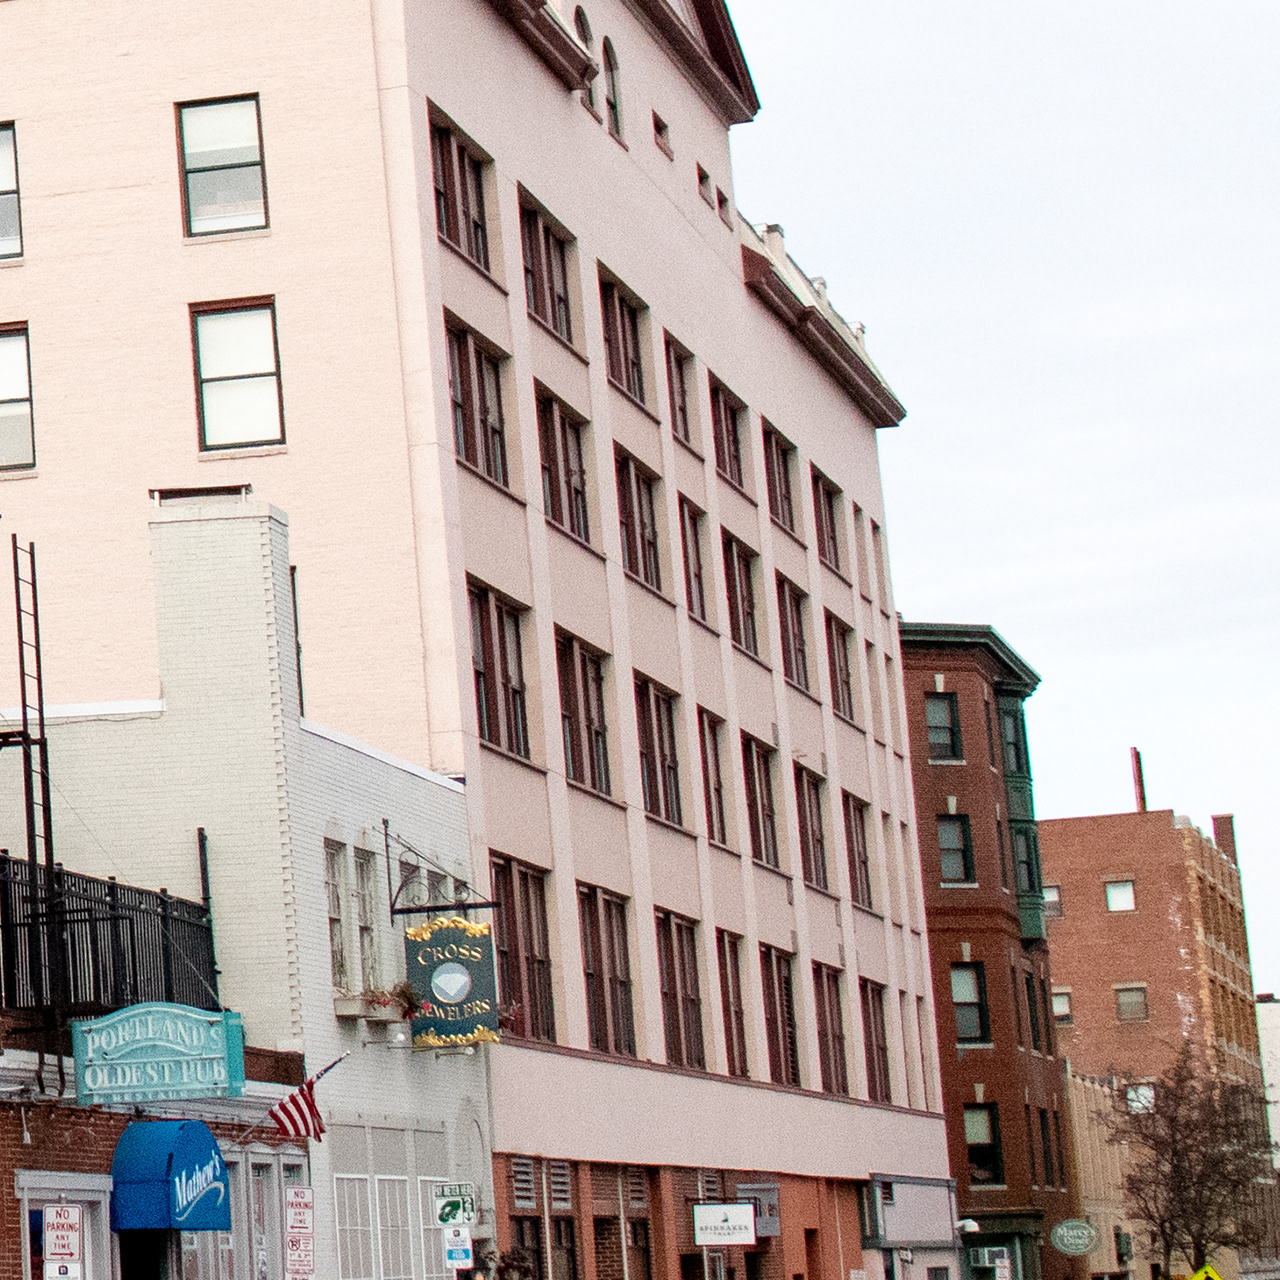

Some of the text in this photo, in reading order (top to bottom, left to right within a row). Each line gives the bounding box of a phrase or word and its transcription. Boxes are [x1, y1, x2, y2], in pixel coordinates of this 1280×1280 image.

[417, 943, 483, 966] CROSS
[84, 1059, 226, 1089] OLDEST PUB
[174, 1149, 221, 1213] Mathew's
[293, 1190, 306, 1199] NO
[287, 1201, 313, 1209] PARKING
[55, 1209, 70, 1220] NO
[46, 1222, 79, 1232] PARKING
